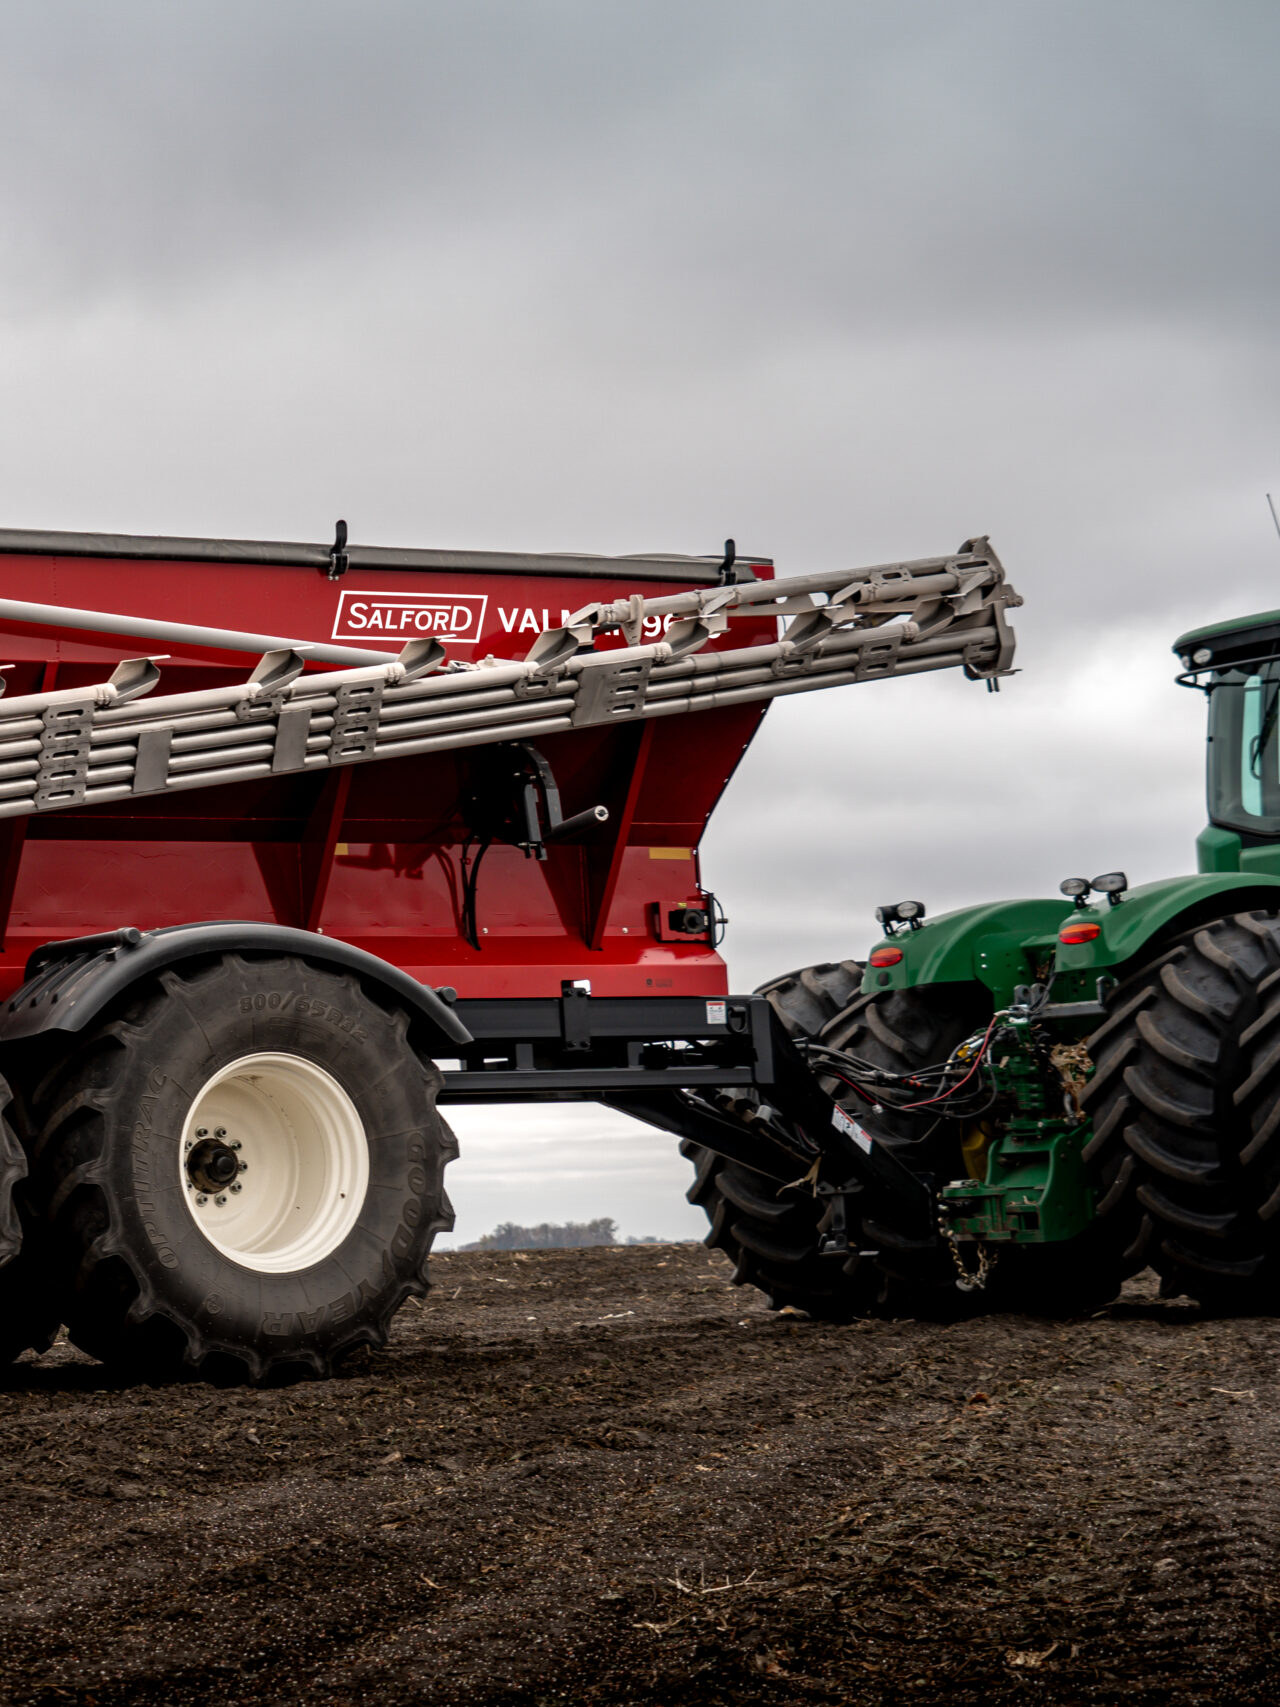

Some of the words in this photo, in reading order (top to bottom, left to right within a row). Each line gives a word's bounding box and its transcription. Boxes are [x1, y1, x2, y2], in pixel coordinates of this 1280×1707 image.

[347, 602, 472, 631] SALFORD
[497, 607, 620, 635] VAL
[239, 991, 369, 1045] 800/65R32
[132, 1065, 179, 1269] OPTITRAC
[263, 1132, 425, 1336] GOODYEAR
